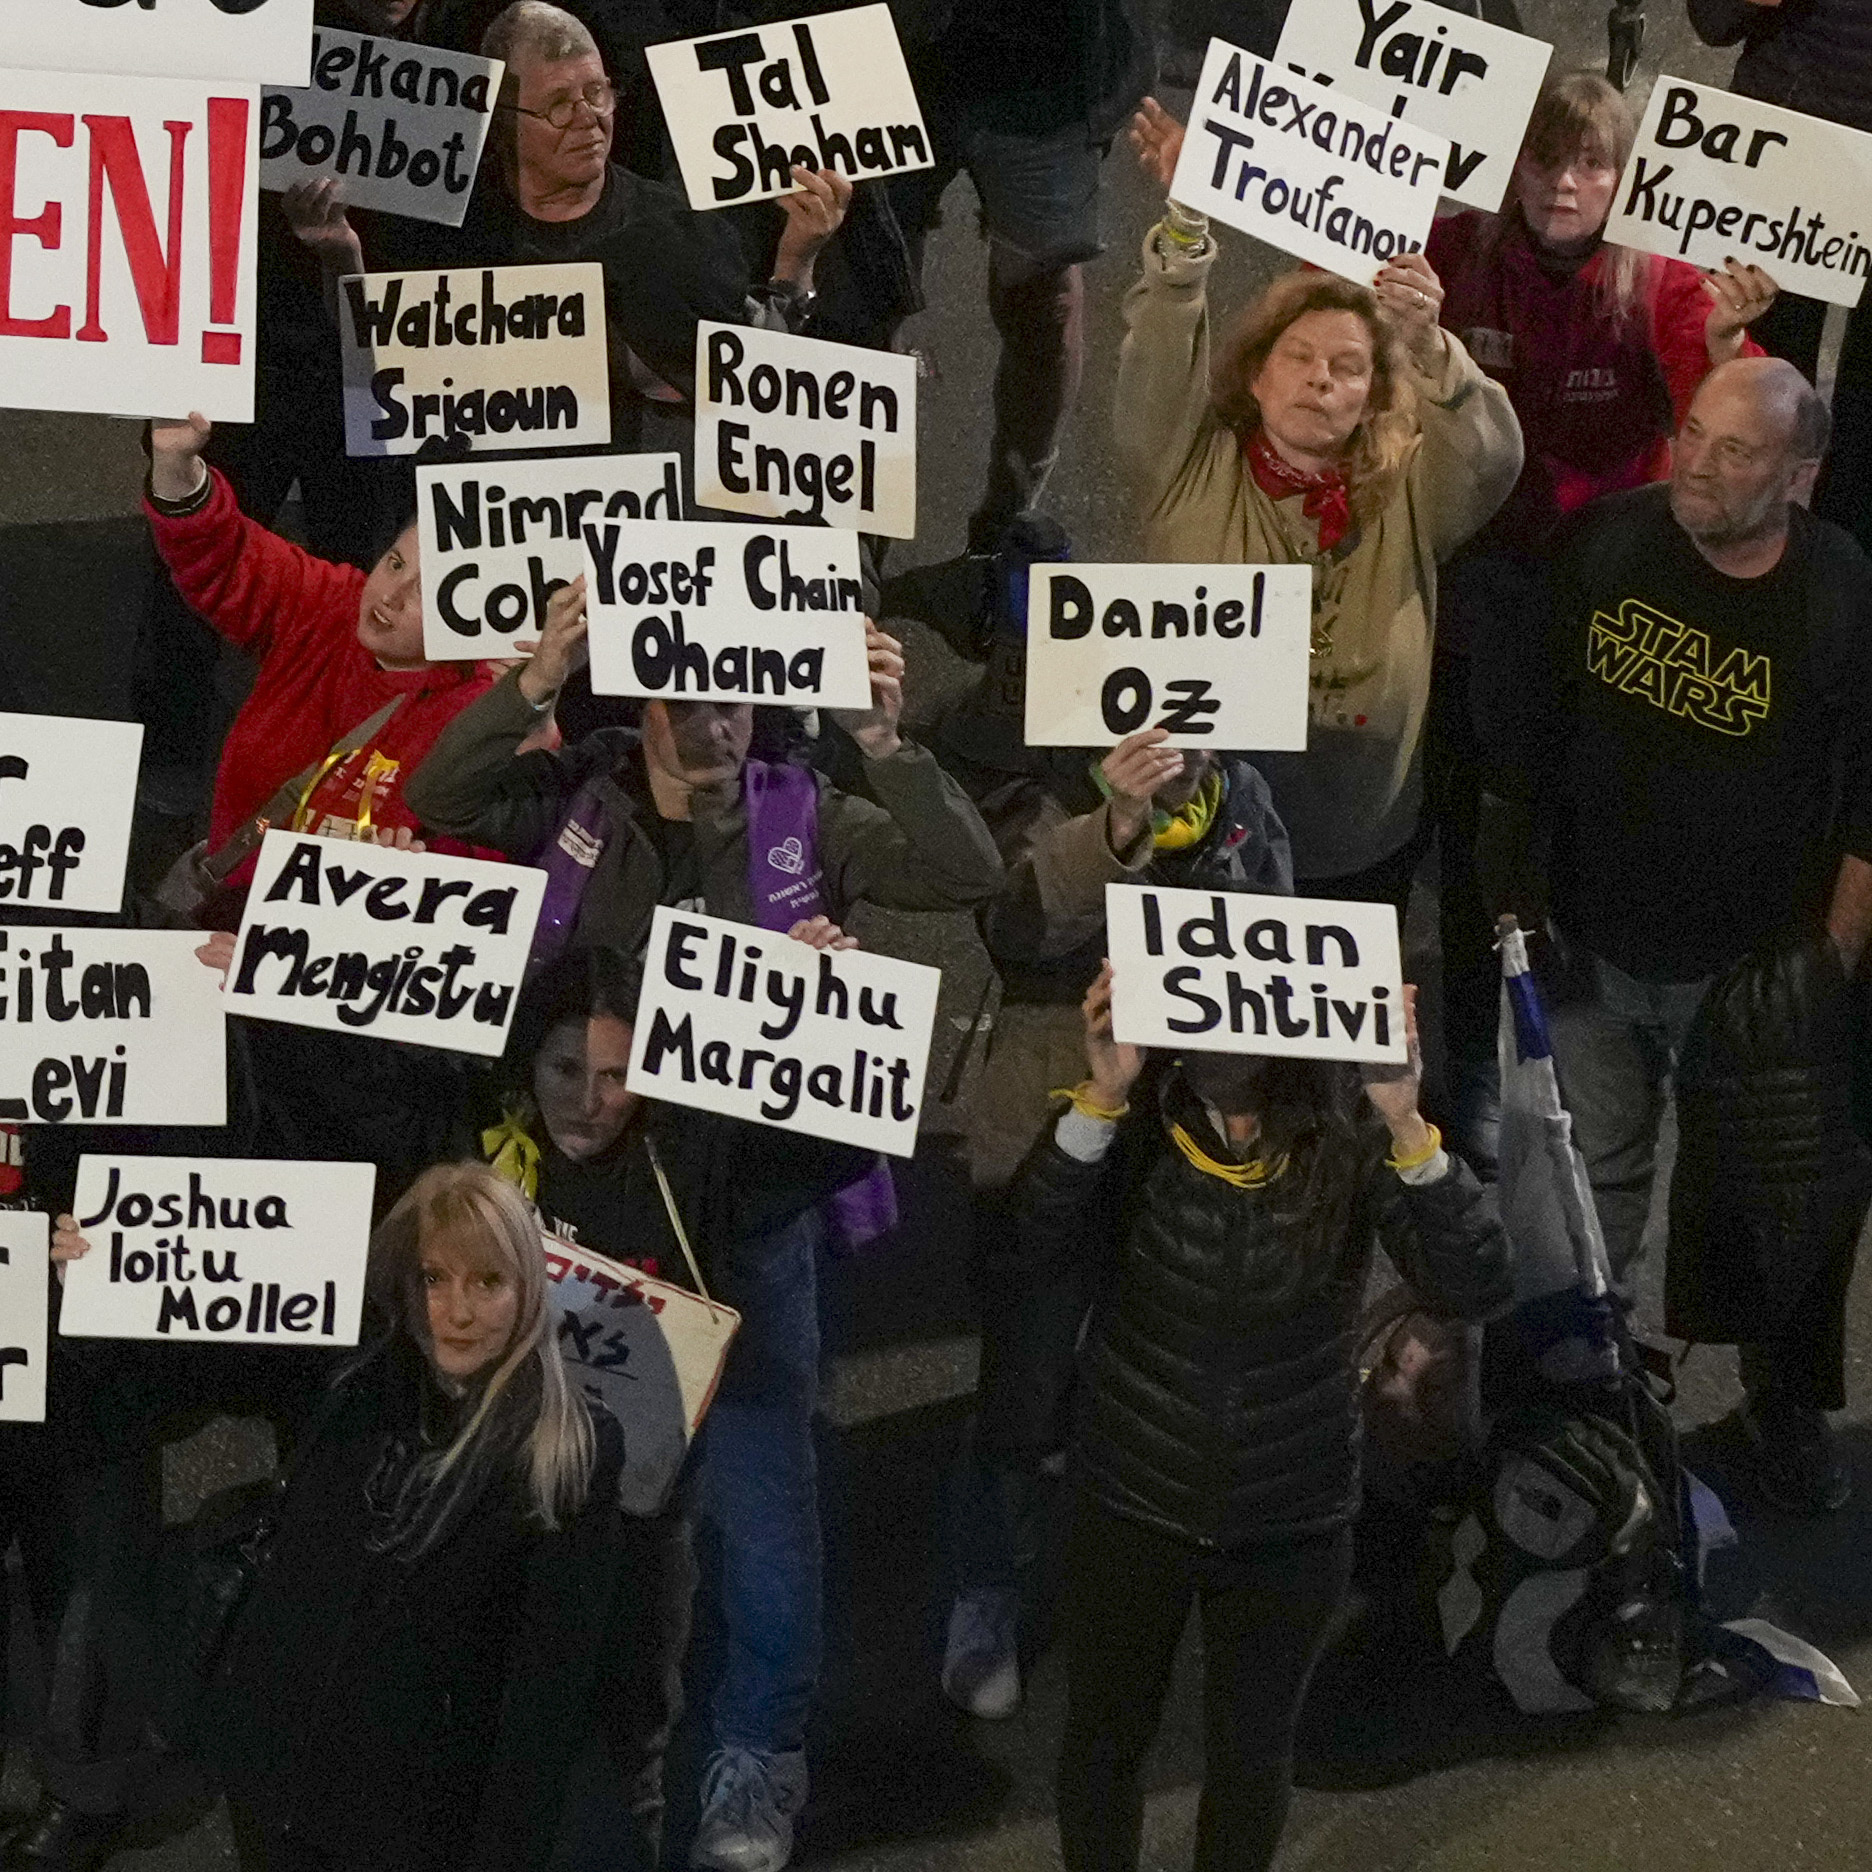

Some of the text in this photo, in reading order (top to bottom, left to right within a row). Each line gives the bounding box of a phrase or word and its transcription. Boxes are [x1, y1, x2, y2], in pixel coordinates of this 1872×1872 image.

[693, 23, 832, 117] Tal
[258, 94, 472, 195] Bohbot
[1209, 51, 1441, 190] Alexander
[1652, 85, 1789, 171] Bar
[344, 271, 586, 350] Watchara
[708, 330, 901, 434] Ronen
[718, 421, 876, 519] Engel
[1046, 572, 1268, 641] Daniel
[630, 614, 827, 696] Ohana
[1099, 664, 1223, 736] Oz
[1587, 628, 1772, 737] WARS
[264, 841, 520, 936] Avera
[1162, 966, 1393, 1048] Shtivi
[640, 1006, 916, 1124] Margalit
[155, 1280, 337, 1338] Mollel
